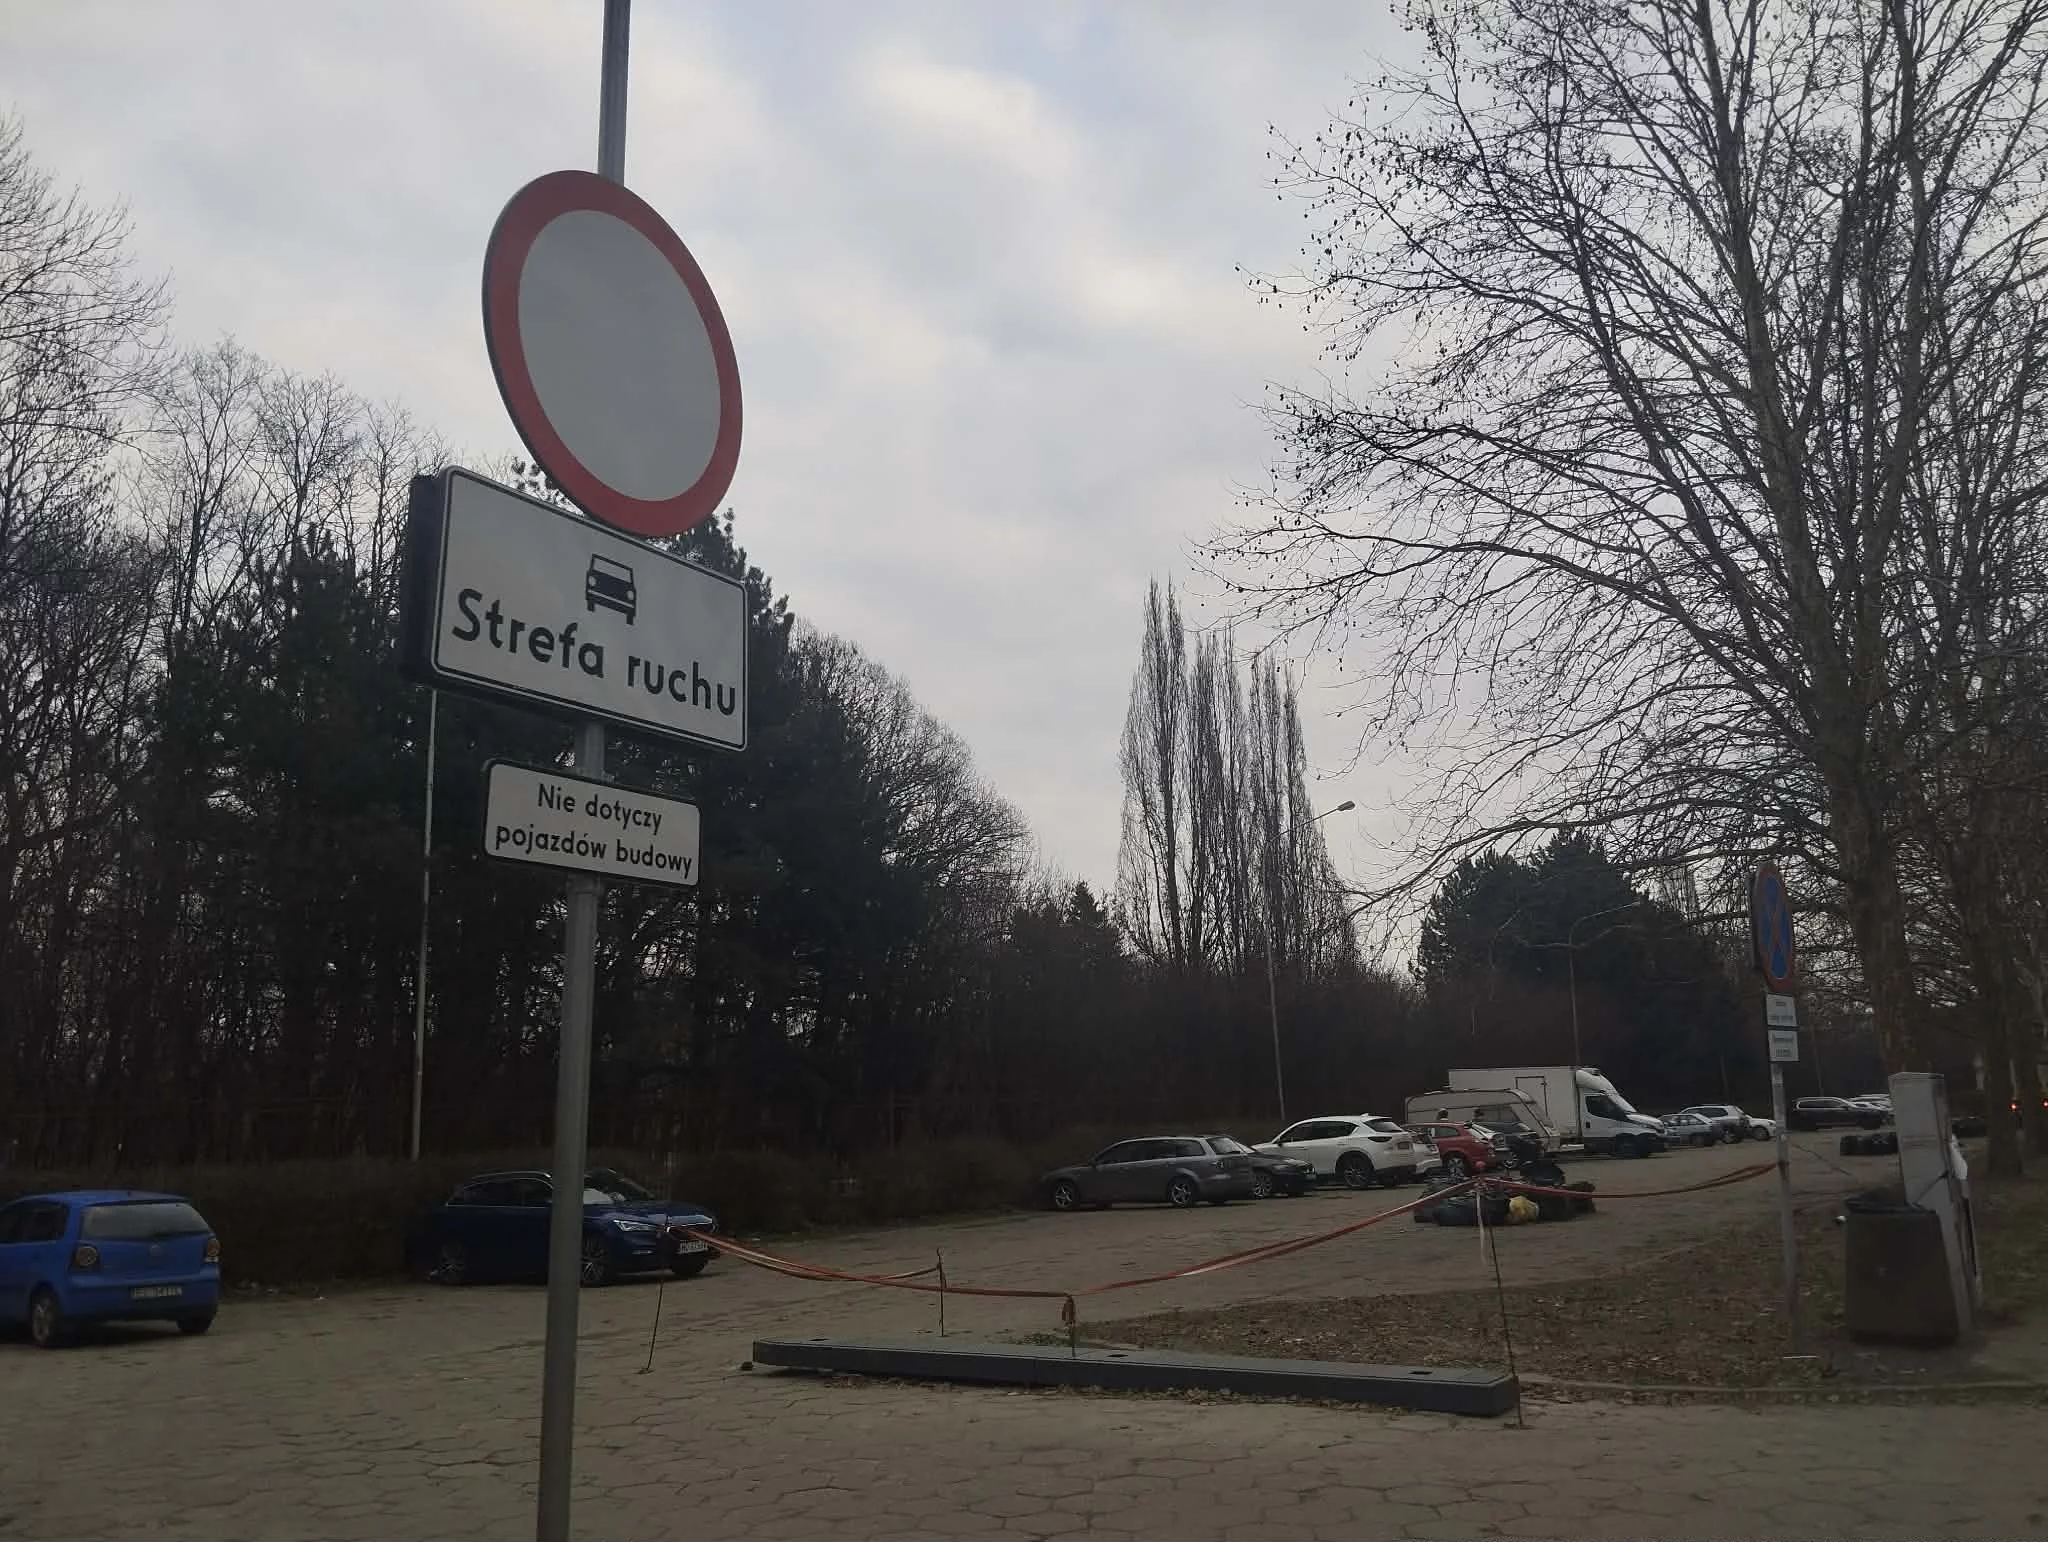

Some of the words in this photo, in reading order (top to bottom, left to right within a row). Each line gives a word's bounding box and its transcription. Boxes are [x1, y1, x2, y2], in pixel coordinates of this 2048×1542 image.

[452, 588, 605, 679] Strefa
[628, 655, 736, 716] ruchu
[538, 783, 576, 813] Nie
[585, 794, 662, 835] dotyczy
[496, 824, 606, 859] pojazdów
[616, 839, 692, 879] budowy
